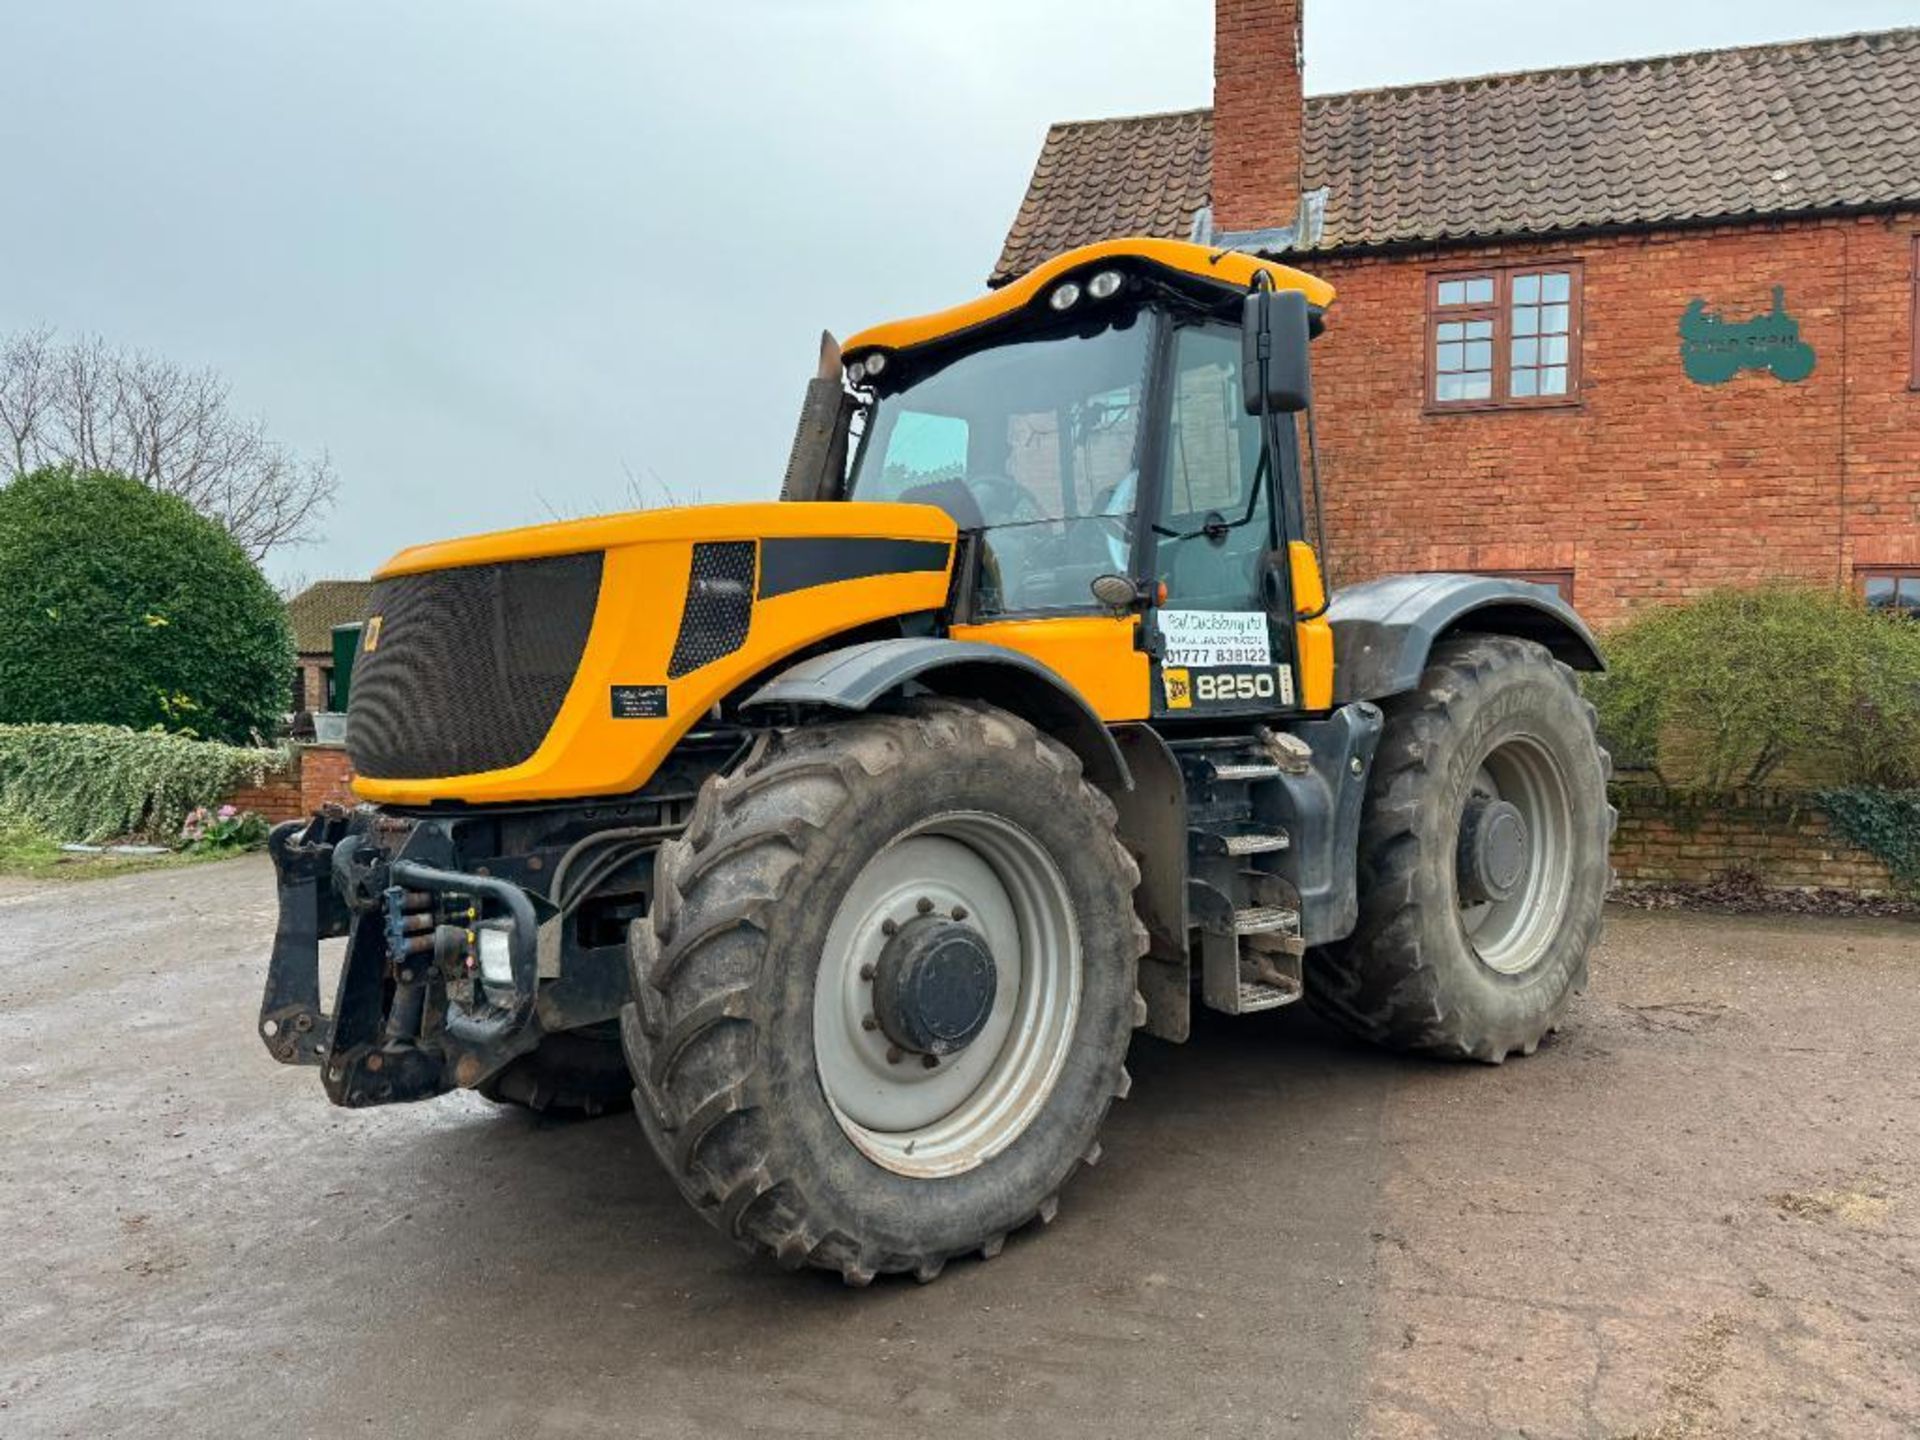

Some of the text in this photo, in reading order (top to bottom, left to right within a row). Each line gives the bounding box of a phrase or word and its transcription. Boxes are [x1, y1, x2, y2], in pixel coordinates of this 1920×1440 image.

[1166, 648, 1267, 663] 01777 838122
[1196, 673, 1274, 699] 8250
